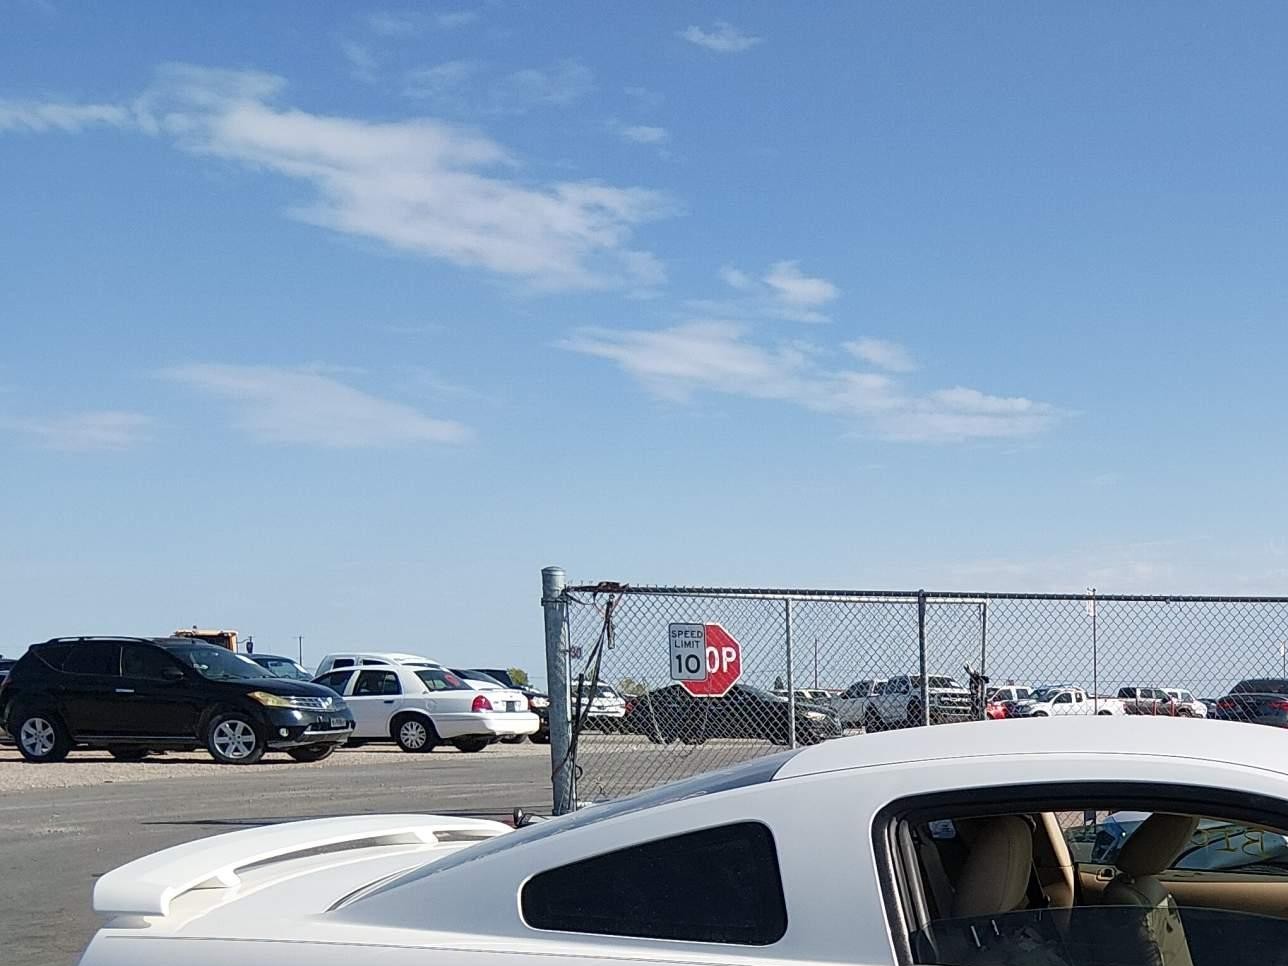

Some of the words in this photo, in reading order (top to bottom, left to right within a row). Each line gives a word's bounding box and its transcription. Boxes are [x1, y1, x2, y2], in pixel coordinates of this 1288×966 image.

[671, 630, 703, 638] SPEED
[674, 640, 700, 649] LIMIT
[676, 654, 700, 673] 10
[706, 646, 736, 673] OP
